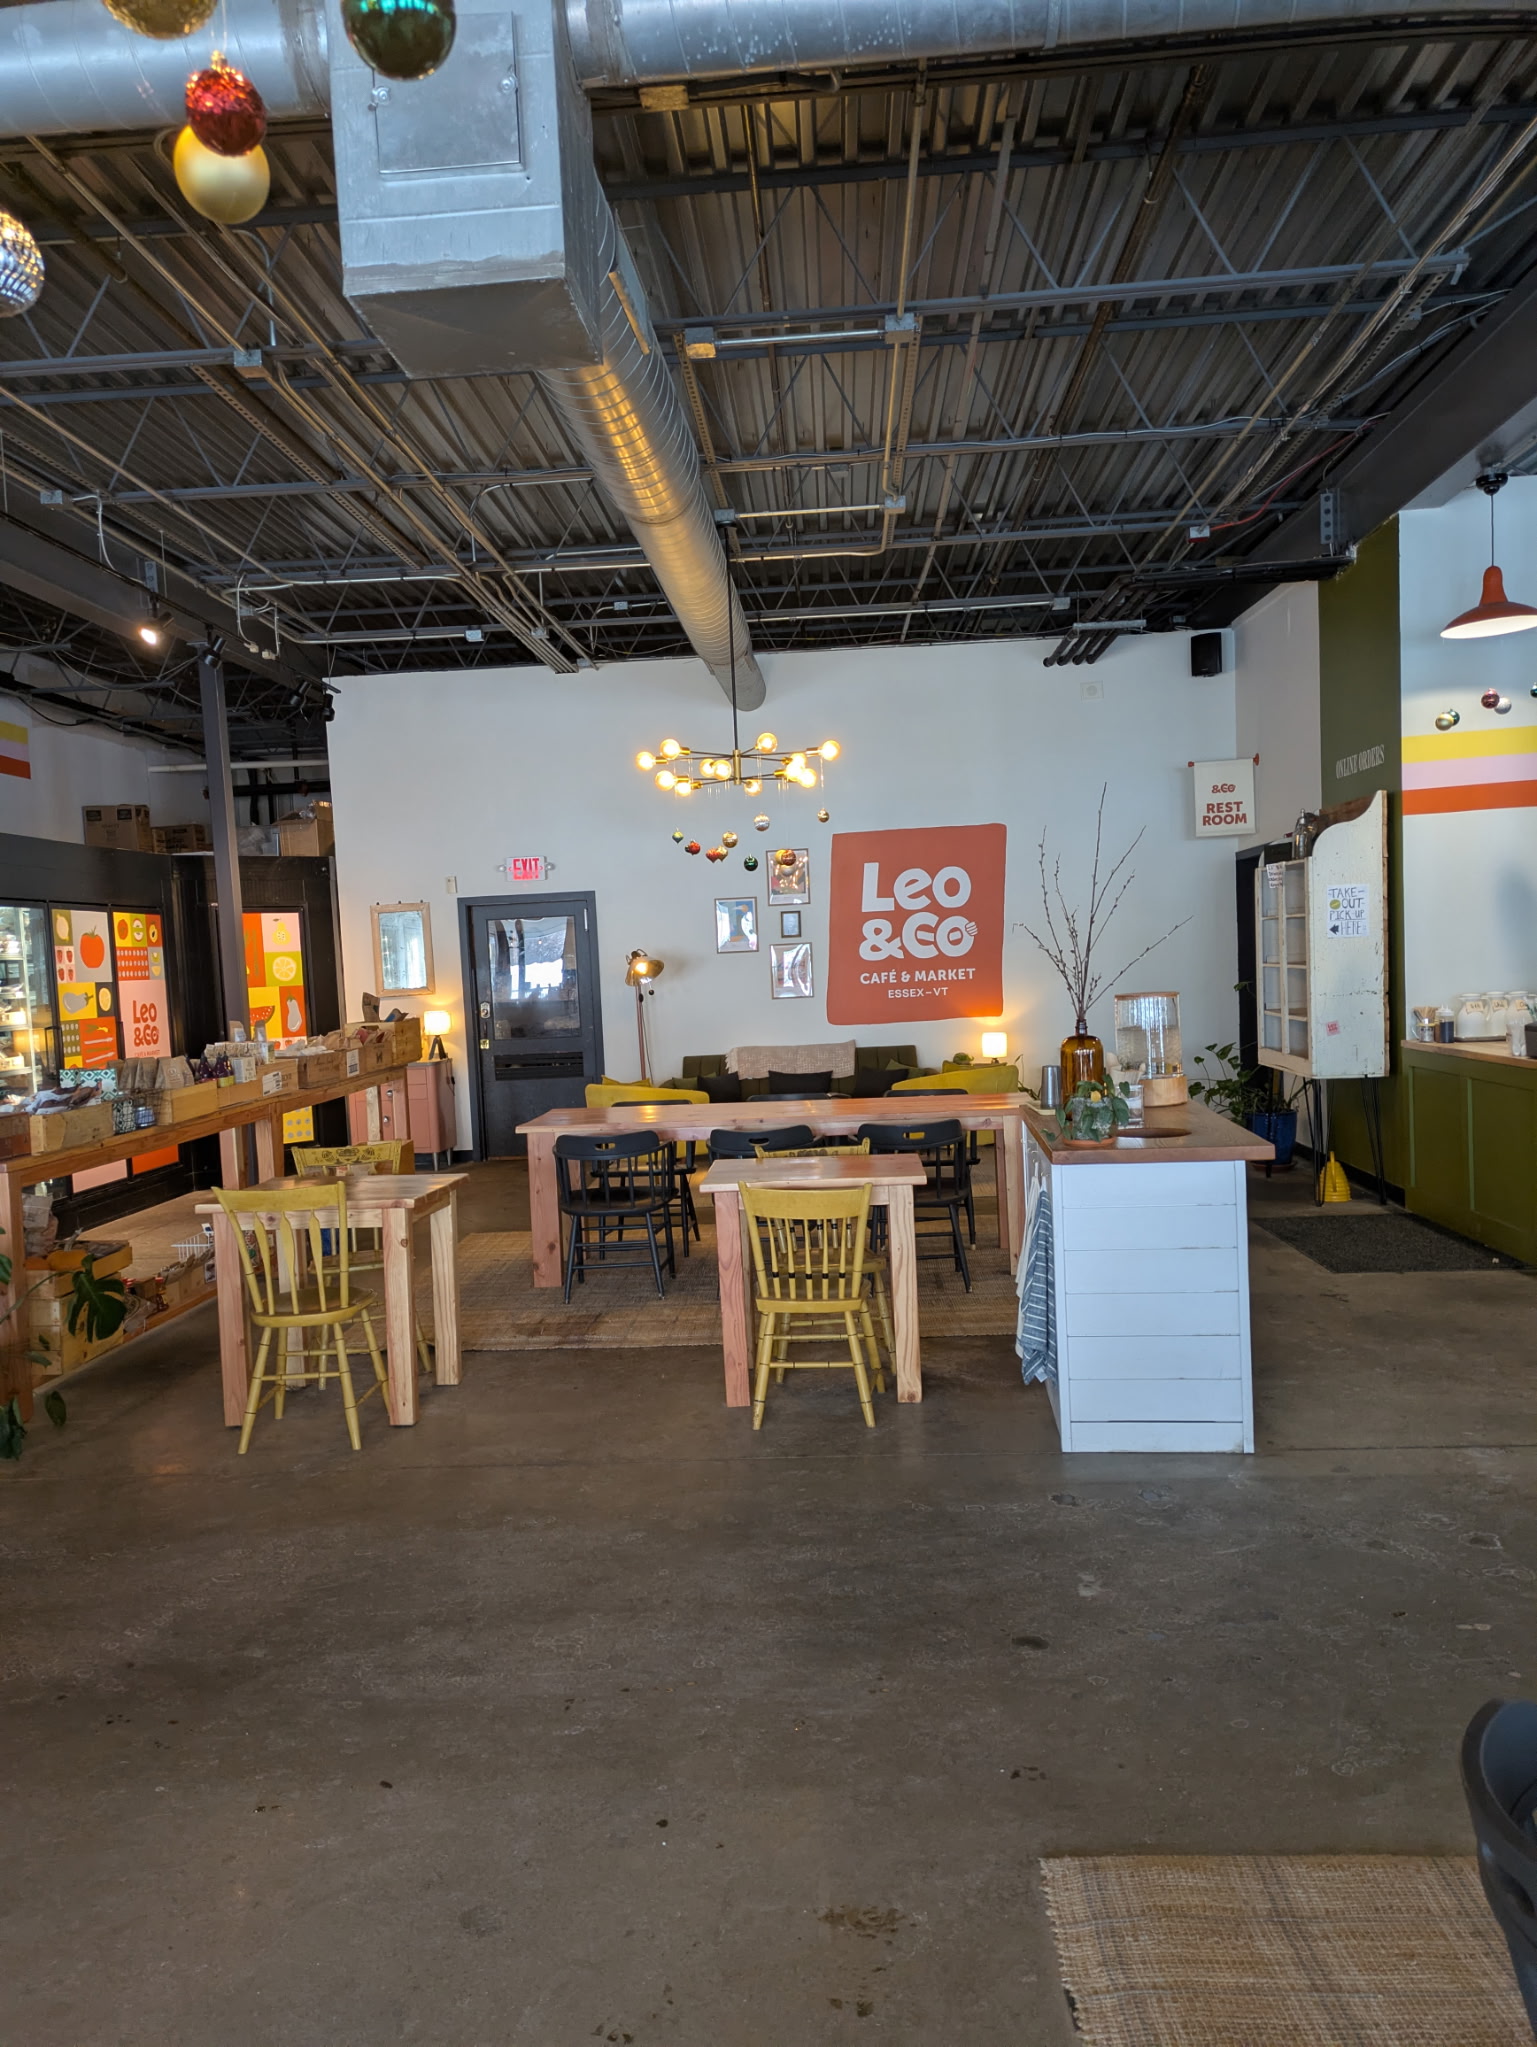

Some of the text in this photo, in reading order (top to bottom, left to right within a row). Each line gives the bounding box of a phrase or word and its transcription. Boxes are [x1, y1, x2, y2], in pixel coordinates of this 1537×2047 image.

[1359, 744, 1385, 772] ORDERS
[1206, 801, 1243, 814] REST
[1202, 813, 1248, 827] ROOM
[513, 858, 540, 880] EXIT
[860, 967, 976, 984] CAFÉ & MARKET
